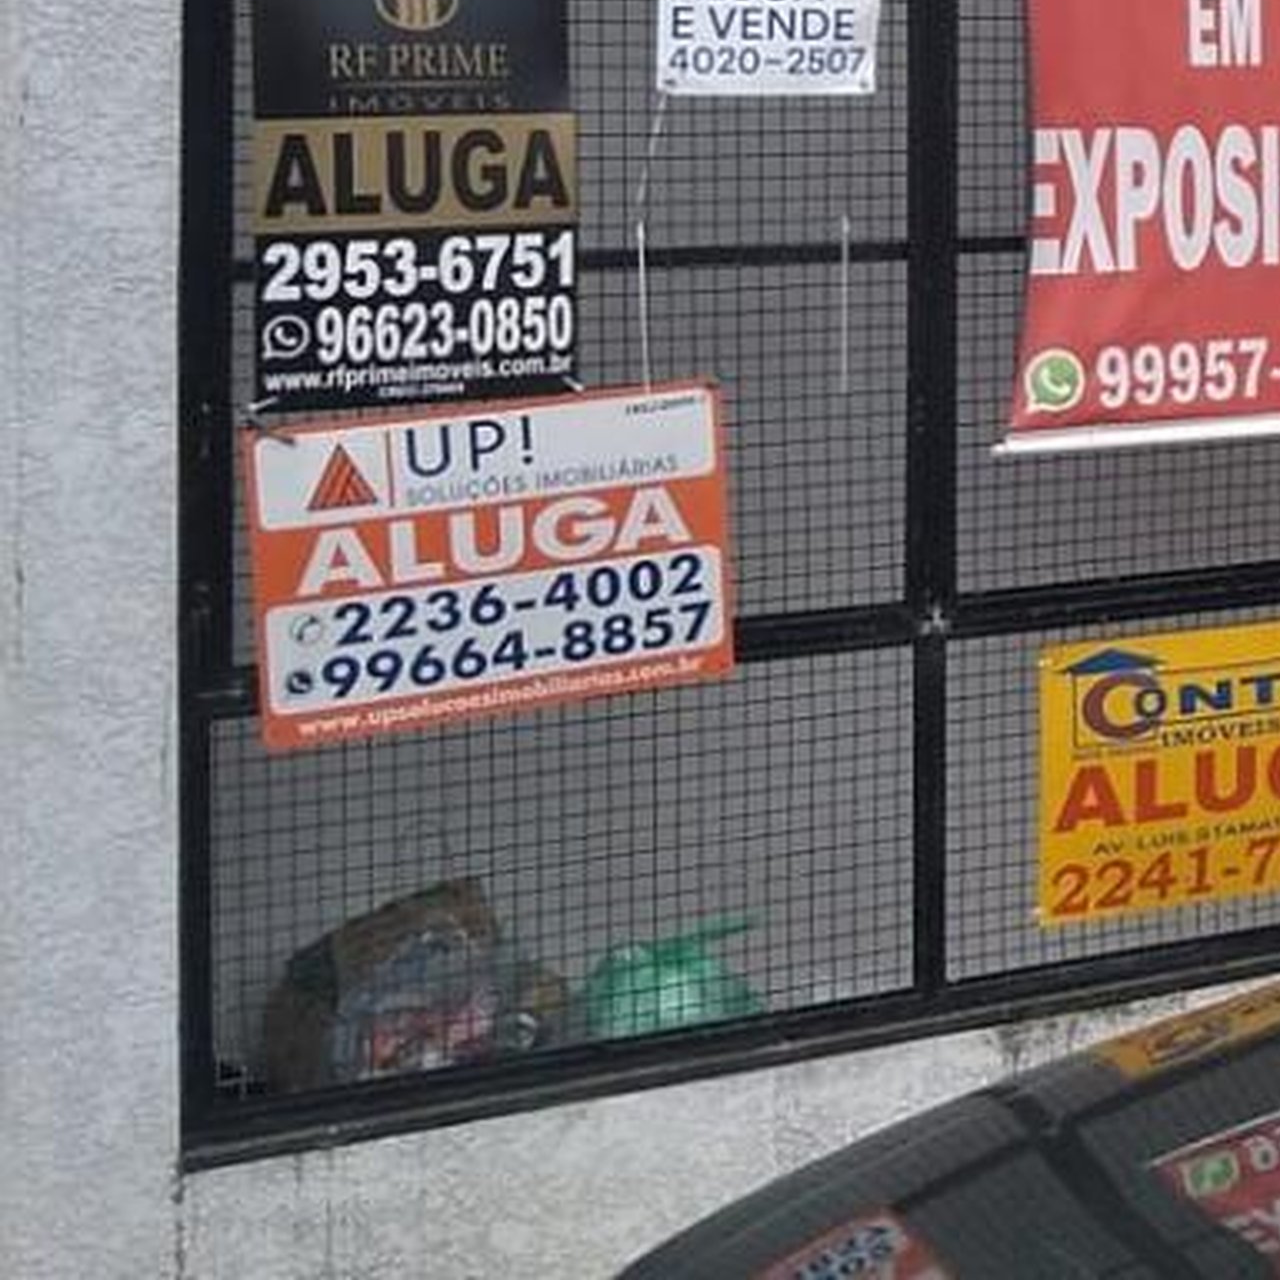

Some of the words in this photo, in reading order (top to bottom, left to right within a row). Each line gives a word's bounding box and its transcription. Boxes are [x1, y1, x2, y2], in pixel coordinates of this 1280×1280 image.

[672, 6, 695, 40] E
[709, 7, 855, 41] VENDE
[329, 43, 378, 78] RF
[389, 43, 511, 78] PRIME
[669, 46, 867, 75] 4020-2507
[265, 129, 571, 217] ALUGA
[262, 231, 575, 301] 2953-6751
[316, 294, 573, 364] 96623-0850
[265, 352, 572, 393] www.rfprimeimoveis.com.br
[406, 415, 533, 478] UP!
[298, 485, 692, 595] ALUGA
[335, 553, 702, 647] 2236-4002
[322, 600, 712, 700] 99664-8857
